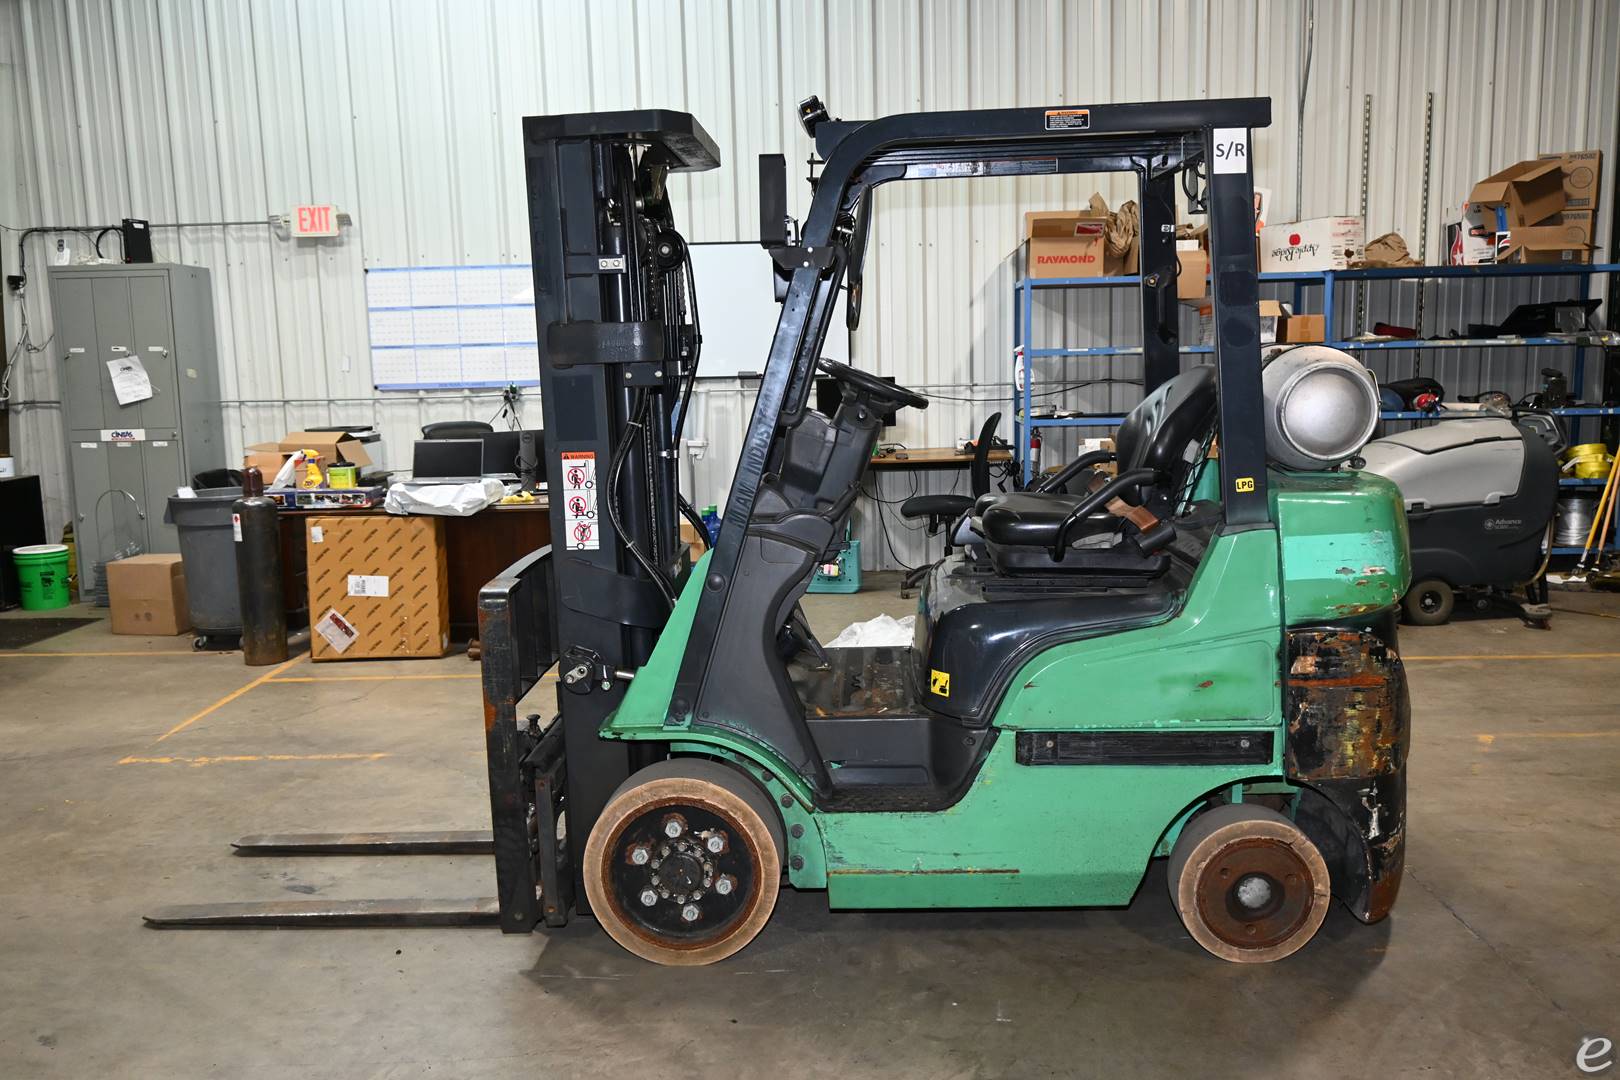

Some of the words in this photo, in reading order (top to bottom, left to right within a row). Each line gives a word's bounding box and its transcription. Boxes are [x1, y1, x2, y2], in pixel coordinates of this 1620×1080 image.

[1216, 141, 1245, 160] S/R
[297, 207, 330, 232] EXIT
[1037, 255, 1096, 264] RAYMOND
[1237, 481, 1253, 489] LPG
